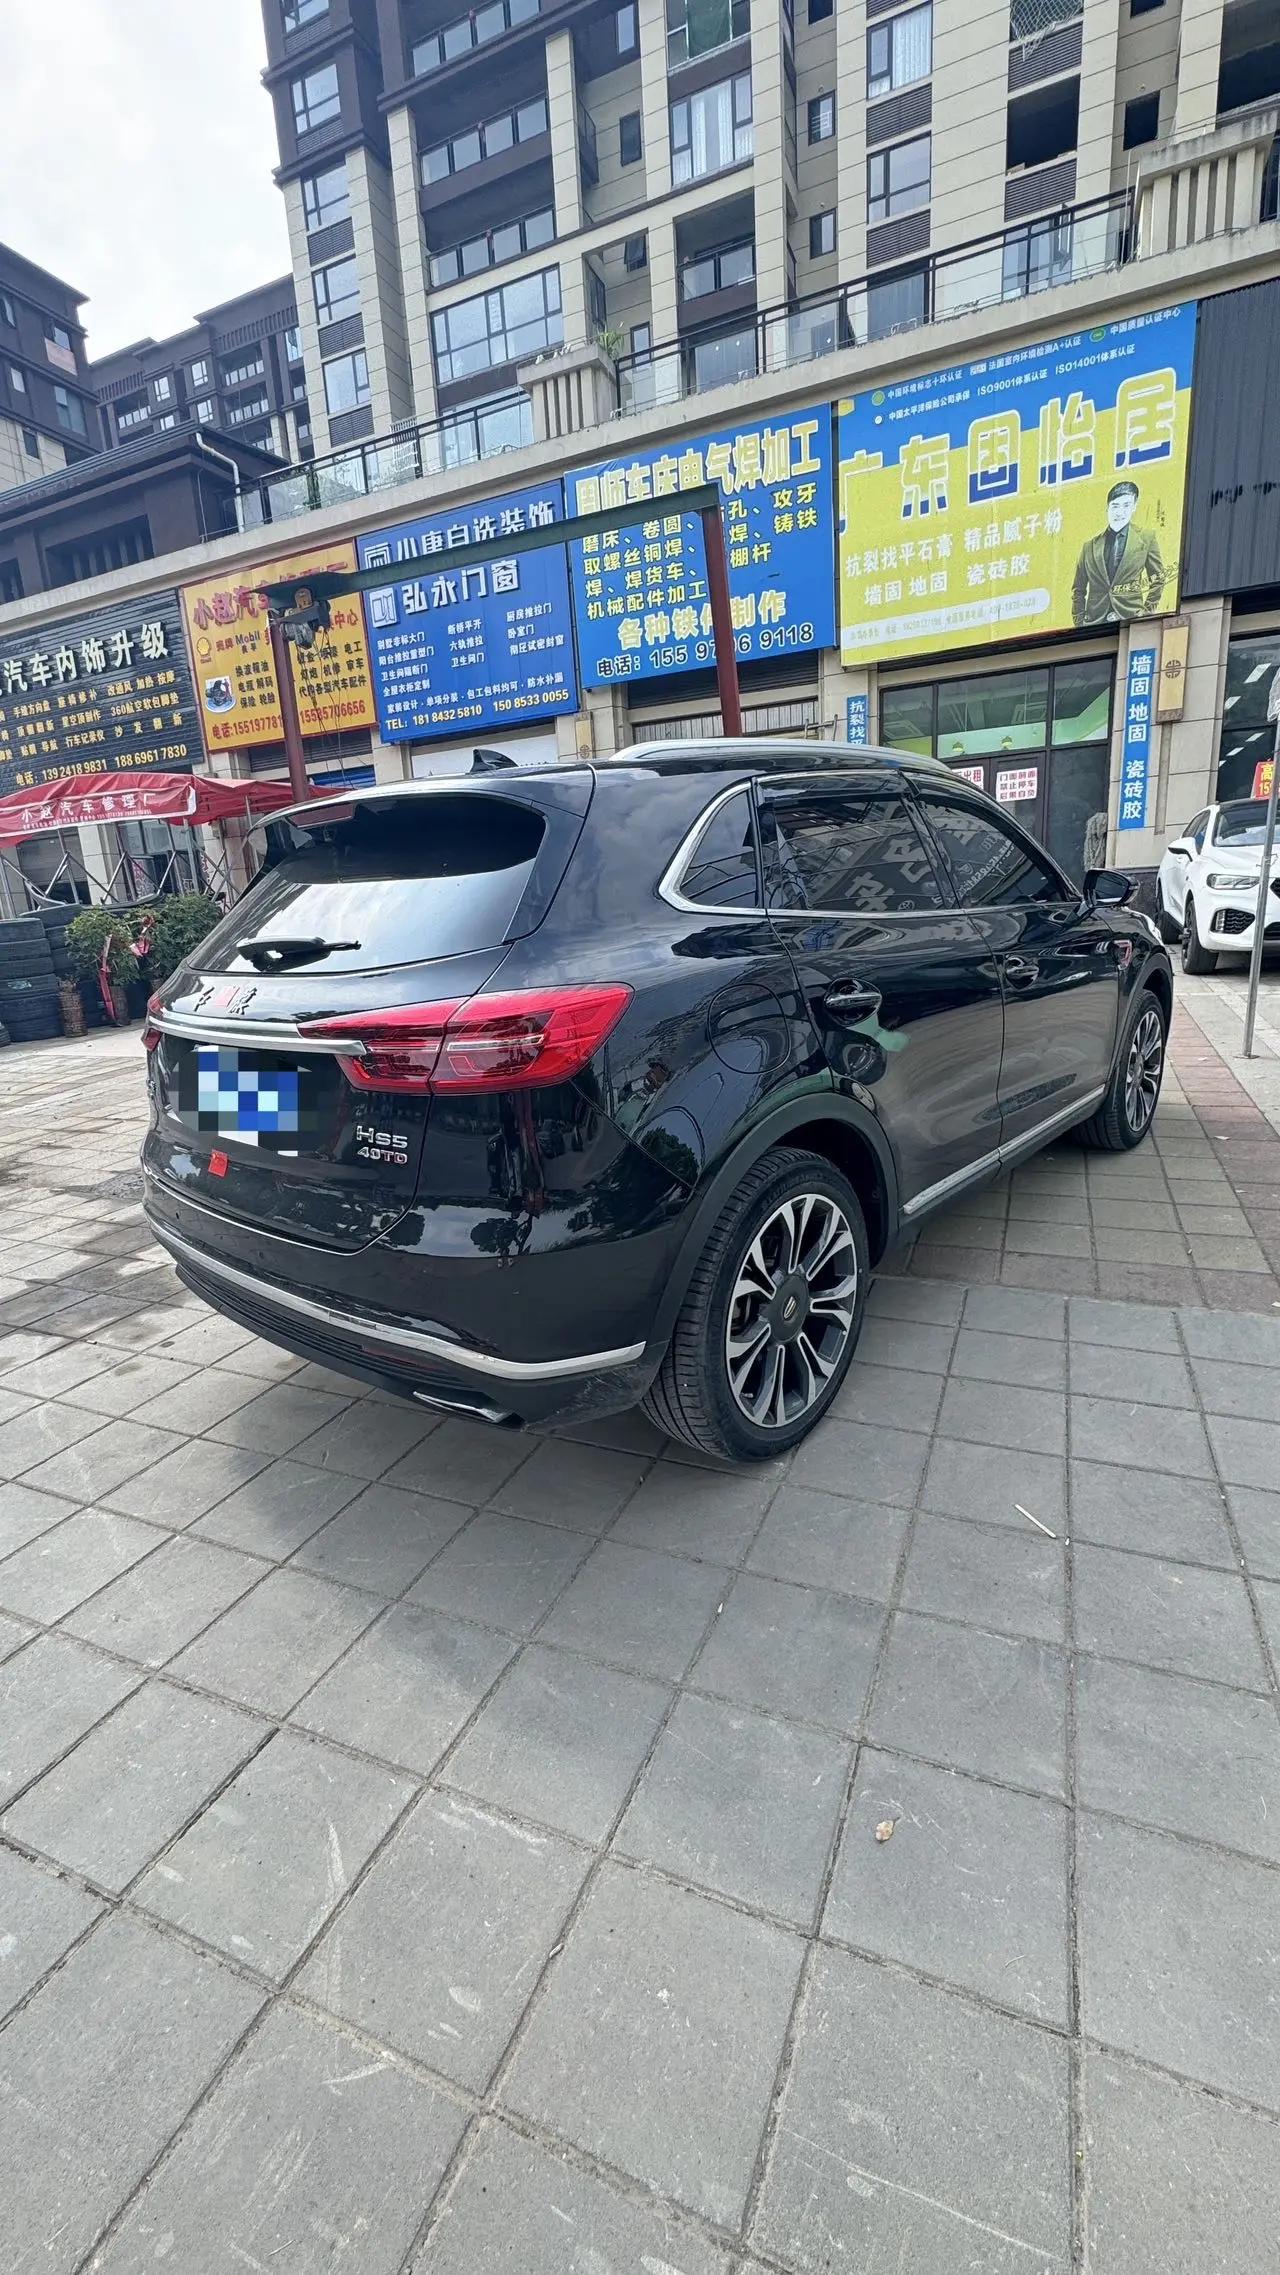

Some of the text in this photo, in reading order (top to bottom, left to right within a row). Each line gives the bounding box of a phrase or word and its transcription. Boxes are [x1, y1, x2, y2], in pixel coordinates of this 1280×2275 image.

[402, 559, 519, 615] 弘永门窗
[587, 580, 707, 620] 机械配件加工
[235, 629, 260, 645] Mobil
[650, 647, 688, 669] 155
[760, 623, 814, 650] 9118
[356, 1125, 408, 1149] HS5
